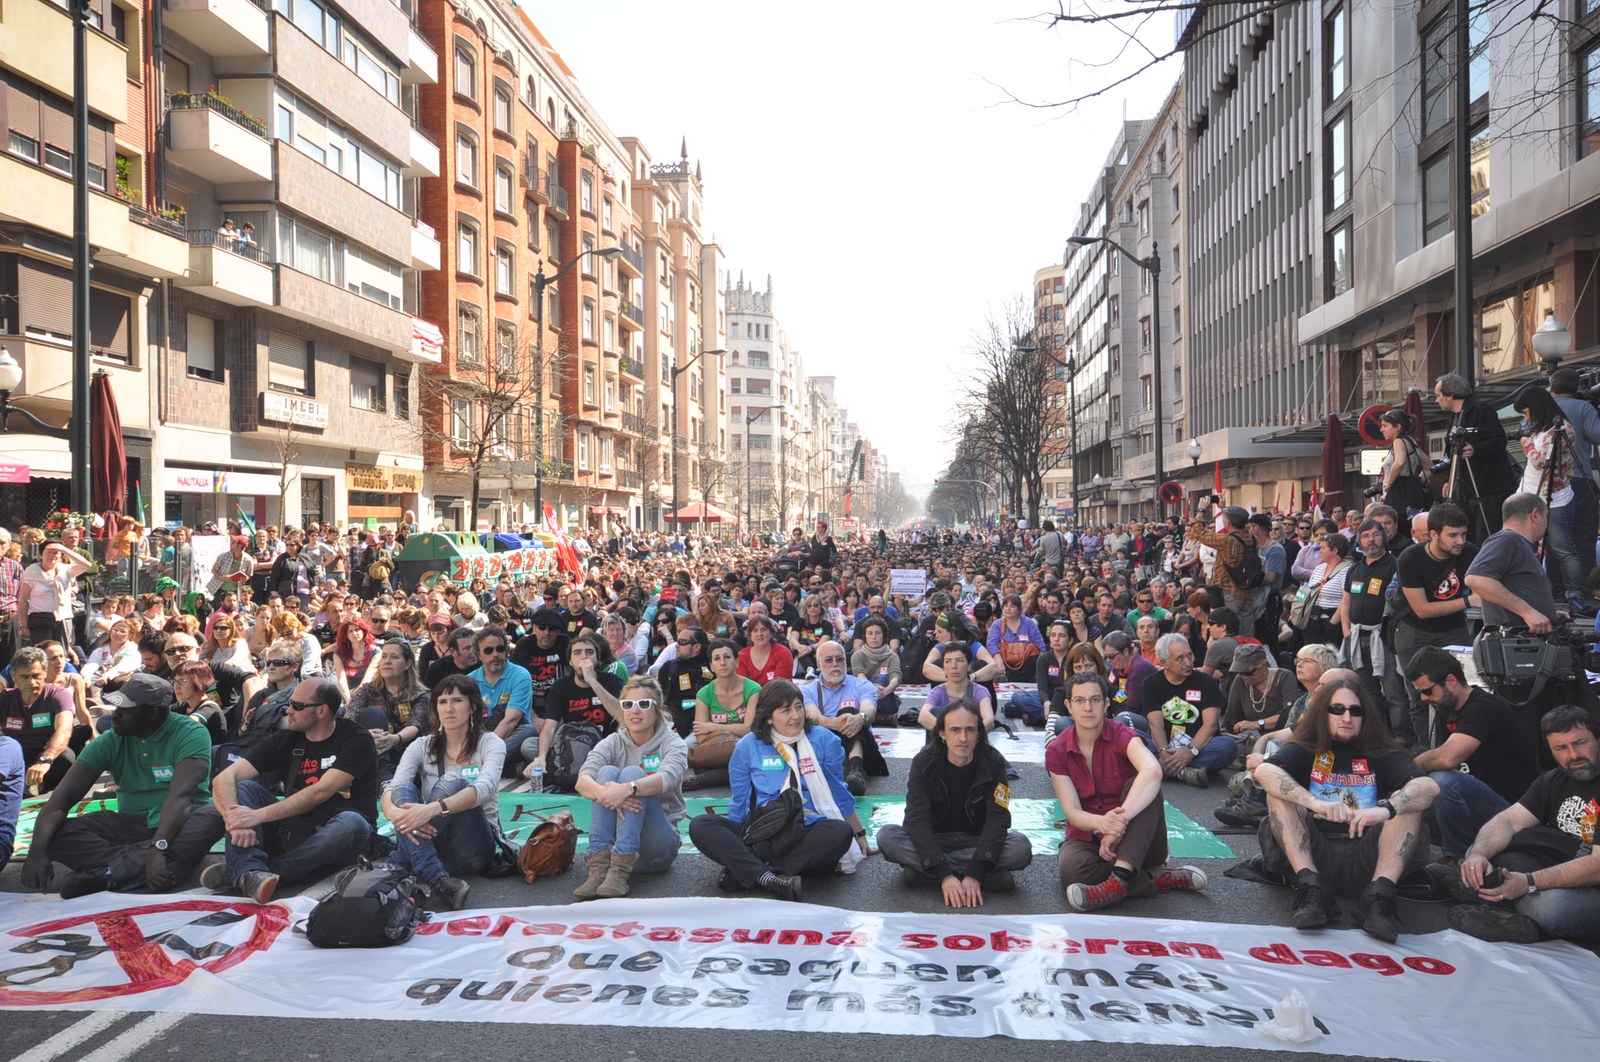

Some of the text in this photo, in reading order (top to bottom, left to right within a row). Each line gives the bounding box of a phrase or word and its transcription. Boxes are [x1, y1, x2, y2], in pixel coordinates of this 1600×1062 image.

[283, 397, 320, 416] IMEBI
[177, 476, 210, 487] NAUTALIA
[507, 551, 524, 572] 29
[453, 557, 471, 582] 29
[569, 698, 590, 709] Tinko
[32, 716, 49, 725] ELA
[643, 756, 661, 769] ELA
[763, 758, 783, 767] ELA
[154, 768, 174, 778] ELA
[461, 768, 480, 776] ELA
[900, 930, 1226, 959] soberan
[1248, 943, 1457, 977] dago
[506, 944, 1229, 993] Que paguen más
[405, 975, 751, 1009] quienes
[785, 985, 978, 1018] más
